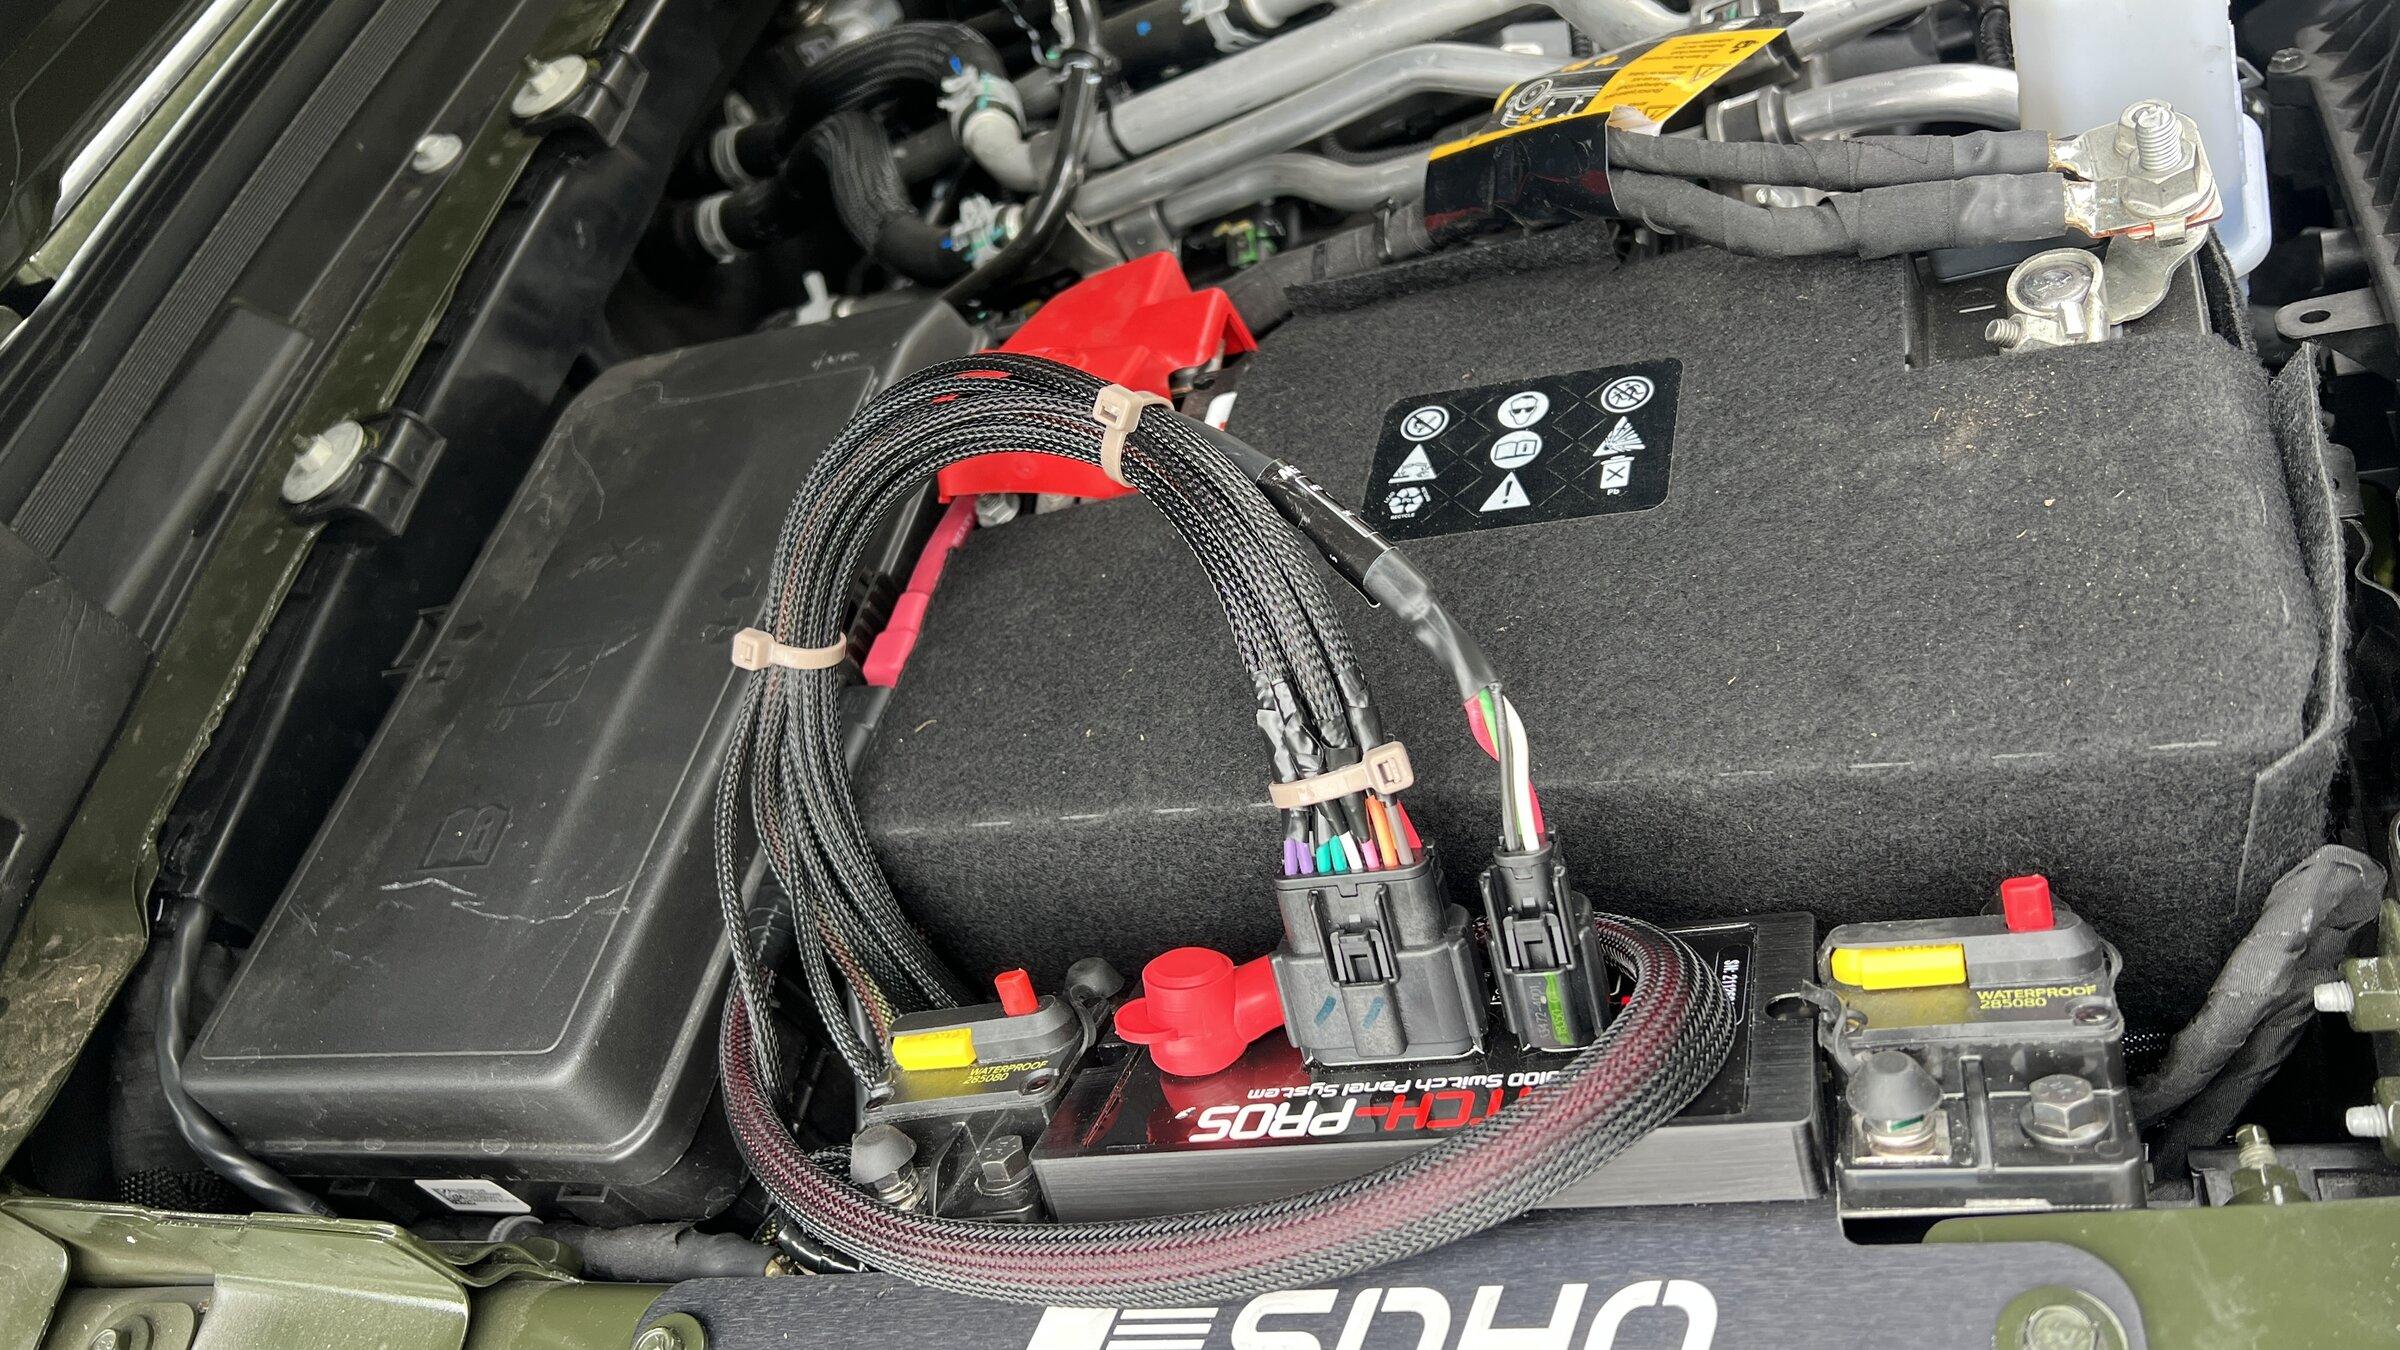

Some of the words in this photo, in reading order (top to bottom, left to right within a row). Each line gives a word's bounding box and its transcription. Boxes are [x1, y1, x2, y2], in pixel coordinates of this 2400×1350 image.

[1606, 488, 1621, 496] Pb
[1390, 512, 1416, 521] RECYCLE
[1976, 983, 2097, 999] WATERPROOF
[1979, 997, 2048, 1010] 285080
[970, 1060, 1049, 1076] WATERPROOF
[962, 1072, 1010, 1085] 285080
[1414, 1073, 1504, 1092] Switch
[1247, 1081, 1340, 1099] System
[1341, 1079, 1410, 1096] Panel
